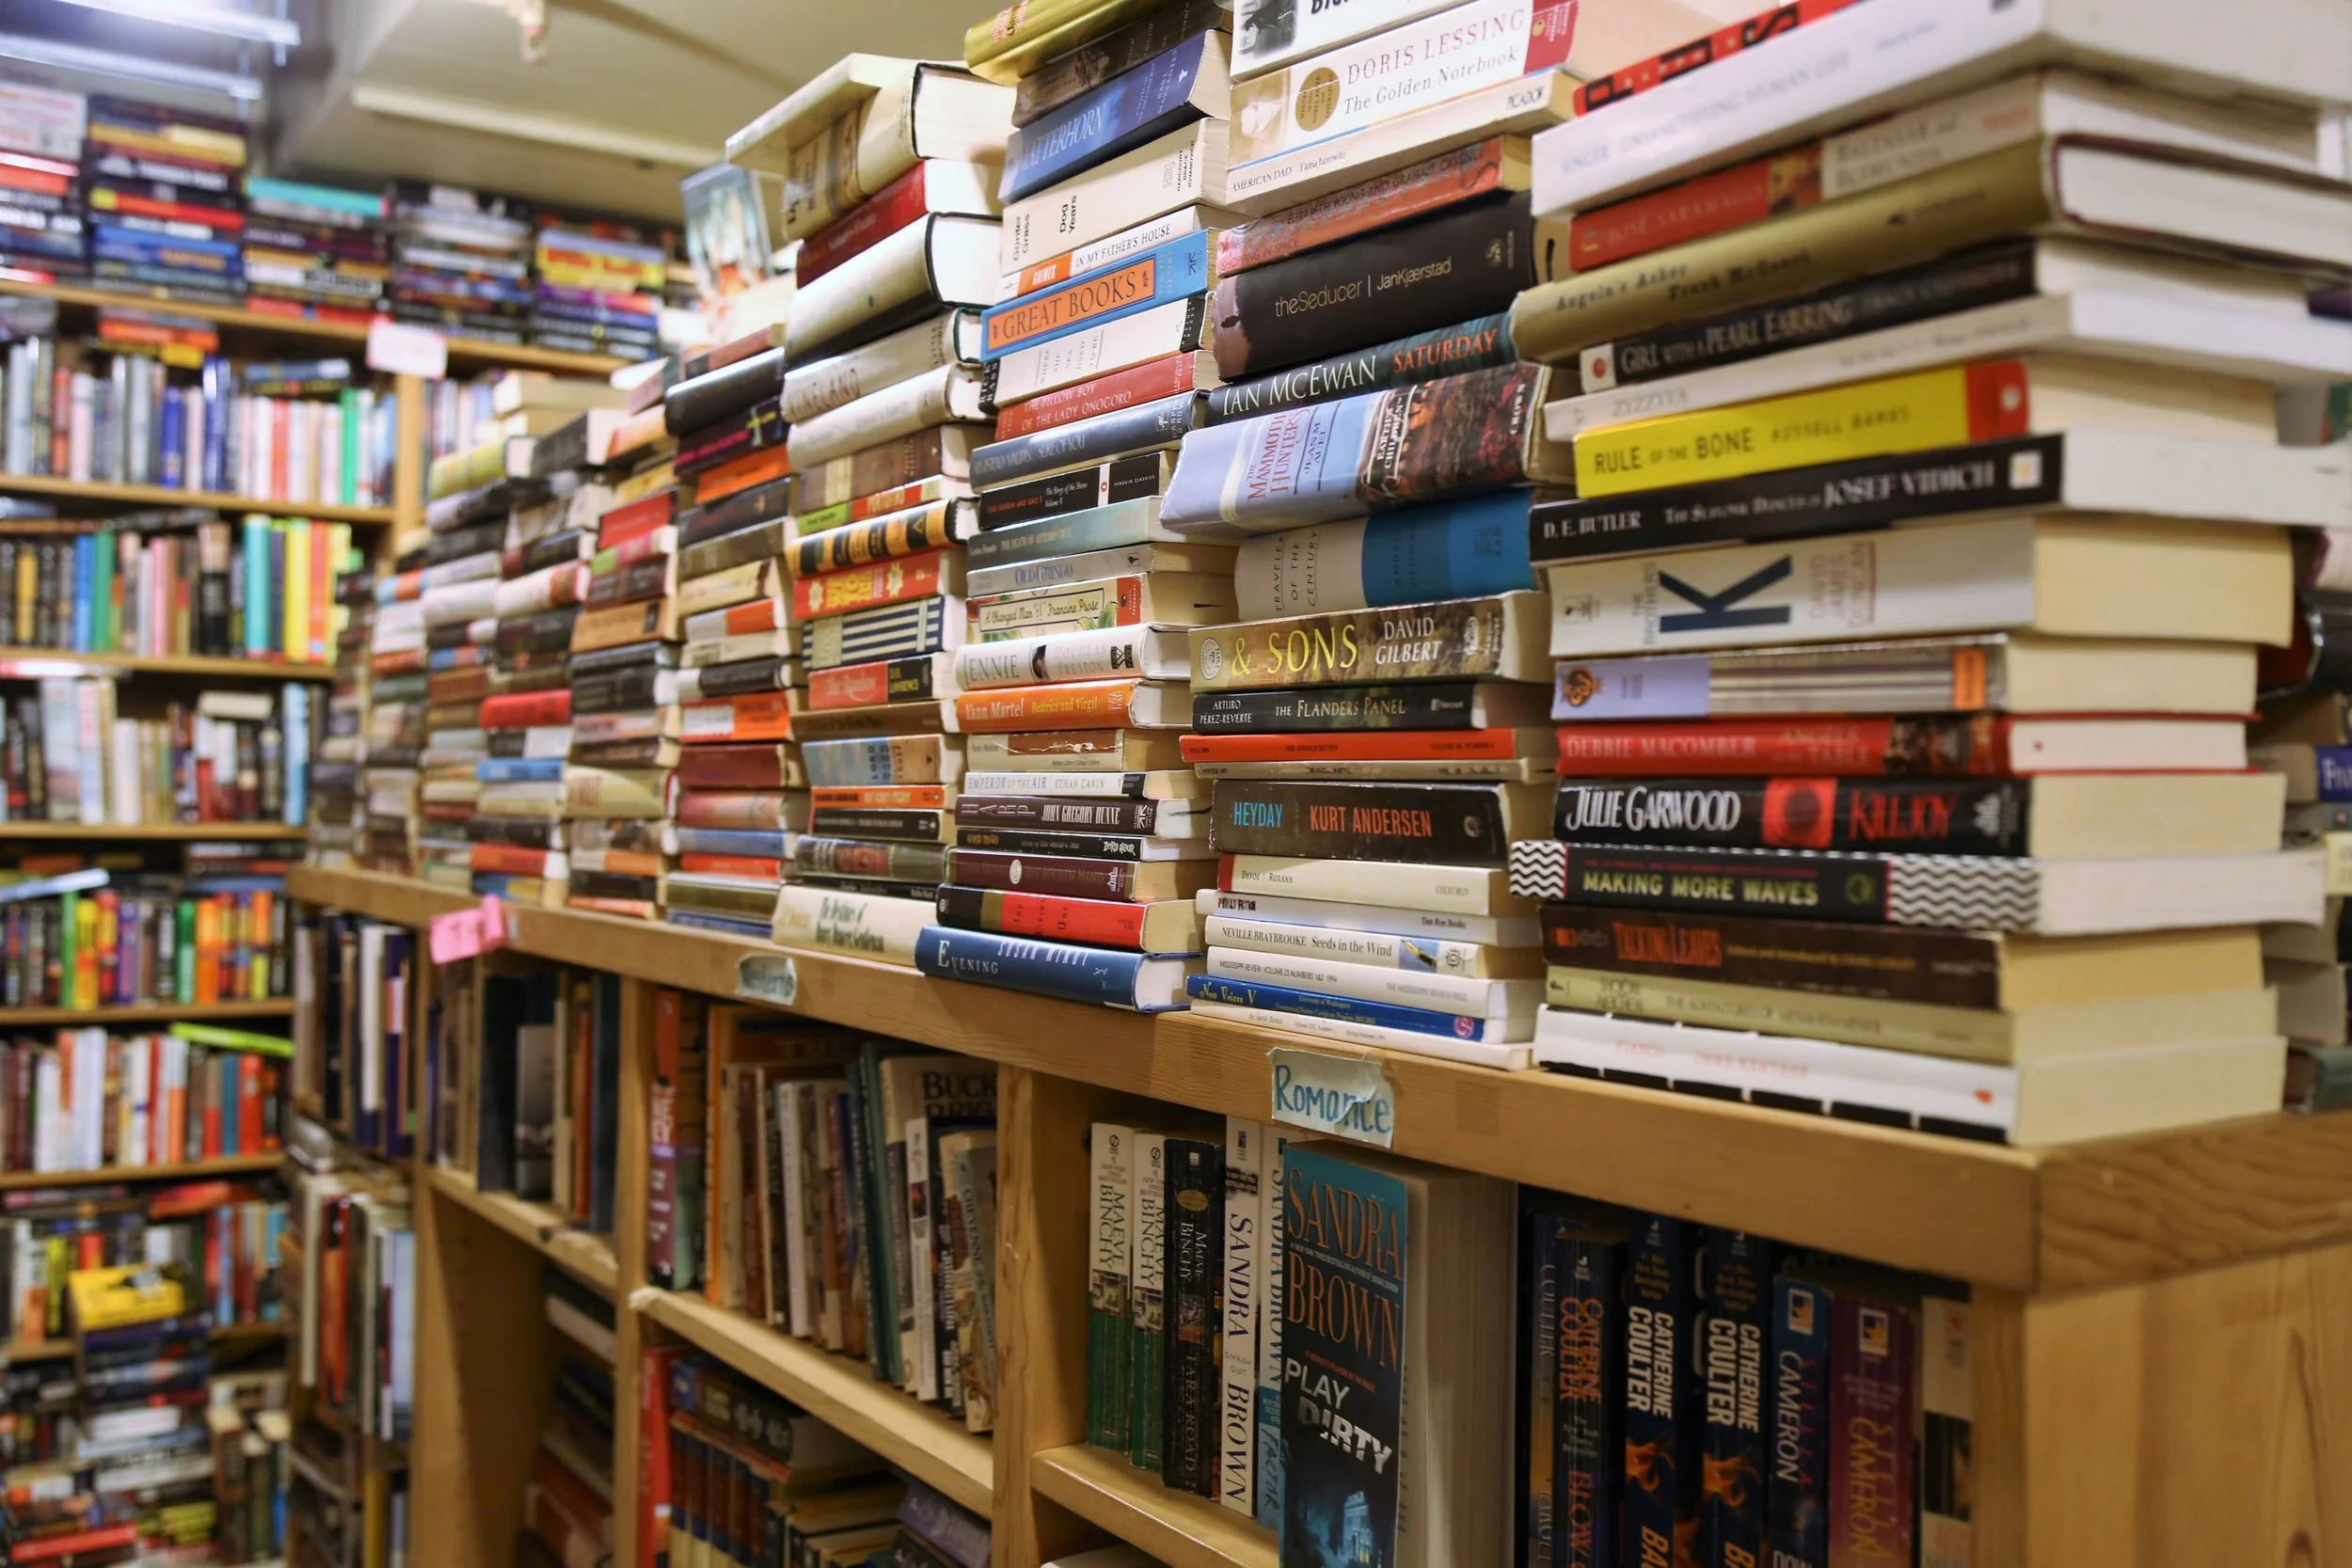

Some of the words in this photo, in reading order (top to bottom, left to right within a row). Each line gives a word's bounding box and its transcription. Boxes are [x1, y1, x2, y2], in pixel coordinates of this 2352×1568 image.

[1347, 46, 1413, 85] DORIS
[1424, 8, 1525, 59] LESSING
[1344, 91, 1371, 114] The
[1376, 73, 1430, 103] Golden
[1439, 46, 1517, 81] Notebook
[1232, 169, 1273, 192] AMERICAN
[1274, 166, 1292, 181] DAD
[1059, 203, 1069, 233] Dog
[1069, 196, 1077, 233] Years
[1076, 256, 1085, 267] IN
[1088, 249, 1101, 263] MY
[1102, 236, 1138, 258] FATHER'S
[1142, 224, 1170, 244] HOUSE
[1220, 253, 1260, 271] SHOPPING
[1262, 248, 1271, 259] IN
[1275, 239, 1298, 255] SPACE
[1003, 299, 1062, 340] GREAT
[1069, 271, 1136, 318] BOOKS
[1275, 279, 1363, 318] theSeducer
[1393, 328, 1498, 374] SATURDAY
[1620, 347, 1661, 375] GIRL
[1705, 323, 1758, 354] PEARL
[1764, 298, 1853, 341] EARRING
[1022, 418, 1032, 430] OF
[1037, 413, 1051, 426] THE
[1055, 405, 1078, 423] LADY
[1082, 391, 1131, 415] ONOGORO
[1025, 399, 1041, 413] THE
[1223, 382, 1262, 417] IAN
[1509, 383, 1526, 436] CROWN
[1248, 415, 1286, 501] MAMMOTH
[1271, 408, 1310, 492] HUNTERS
[1595, 447, 1641, 475] RULE
[1666, 443, 1689, 462] THE
[1695, 426, 1755, 461] BONE
[1054, 484, 1064, 496] Story
[1064, 483, 1070, 495] of
[1246, 464, 1256, 481] THE
[1543, 520, 1560, 541] D.
[1562, 520, 1577, 538] E.
[1579, 511, 1641, 537] BUTLER
[1291, 541, 1300, 563] THE
[1291, 566, 1298, 601] OF
[1659, 554, 1793, 634] K
[1078, 599, 1099, 612] Prose
[1383, 616, 1435, 641] DAVID
[1231, 637, 1251, 676] &
[1267, 625, 1359, 673] SONS
[1375, 640, 1442, 666] GILBERT
[963, 654, 1019, 687] JENNIE
[965, 704, 989, 720] Yann
[991, 698, 1024, 720] Martel
[1060, 700, 1073, 711] and
[1076, 696, 1097, 714] Virgil
[1213, 699, 1241, 711] ARTURO
[1275, 705, 1292, 717] THE
[1297, 699, 1359, 718] FLANDERS
[1363, 696, 1406, 716] PANEL
[1566, 735, 1633, 759] DEBBIE
[1640, 735, 1757, 759] MACOMBER
[969, 777, 1007, 789] EMPEROR
[1032, 777, 1046, 788] AIR
[1055, 778, 1079, 788] ETHAN
[1081, 779, 1105, 788] CANIN
[1041, 804, 1060, 822] JOHN
[1062, 805, 1094, 824] GREGORY
[1233, 801, 1283, 829] HEYDAY
[1310, 805, 1346, 832] KURT
[1353, 809, 1432, 838] ANDERSEN
[1565, 784, 1625, 832] JULIE
[1625, 784, 1742, 832] GARWOOD
[1848, 789, 1960, 842] KILLJOY
[1582, 871, 1663, 895] MAKING
[1672, 875, 1735, 901] MORE
[1742, 879, 1819, 907] WAVES
[937, 940, 998, 978] EVENING
[1222, 927, 1252, 940] NEVILLE
[1253, 931, 1307, 947] BRAYBROOKE
[1311, 936, 1336, 949] Seeds
[1338, 939, 1347, 950] in
[1349, 940, 1364, 953] the
[1367, 942, 1392, 958] Wind
[1291, 970, 1313, 980] NUMBERS
[1247, 990, 1257, 1005] V
[1099, 1184, 1113, 1269] BINCHY
[1112, 1193, 1125, 1266] MAEVE
[1140, 1197, 1155, 1286] BINCHY
[1287, 1166, 1401, 1280] SANDRA
[1181, 1222, 1194, 1281] BINCHY
[1228, 1212, 1254, 1340] SANDRA
[1287, 1251, 1401, 1374] BROWN
[1224, 1351, 1251, 1366] SMASH
[1231, 1365, 1247, 1375] CUT
[1628, 1306, 1652, 1412] COULTER
[1653, 1311, 1674, 1419] CATHERINE
[1707, 1318, 1737, 1426] COULTER
[1739, 1323, 1761, 1433] CATHERINE
[1284, 1357, 1352, 1408] PLAY
[1776, 1350, 1801, 1483] CAMERON
[1225, 1382, 1249, 1505] BROWN
[1296, 1397, 1394, 1477] DIRTY
